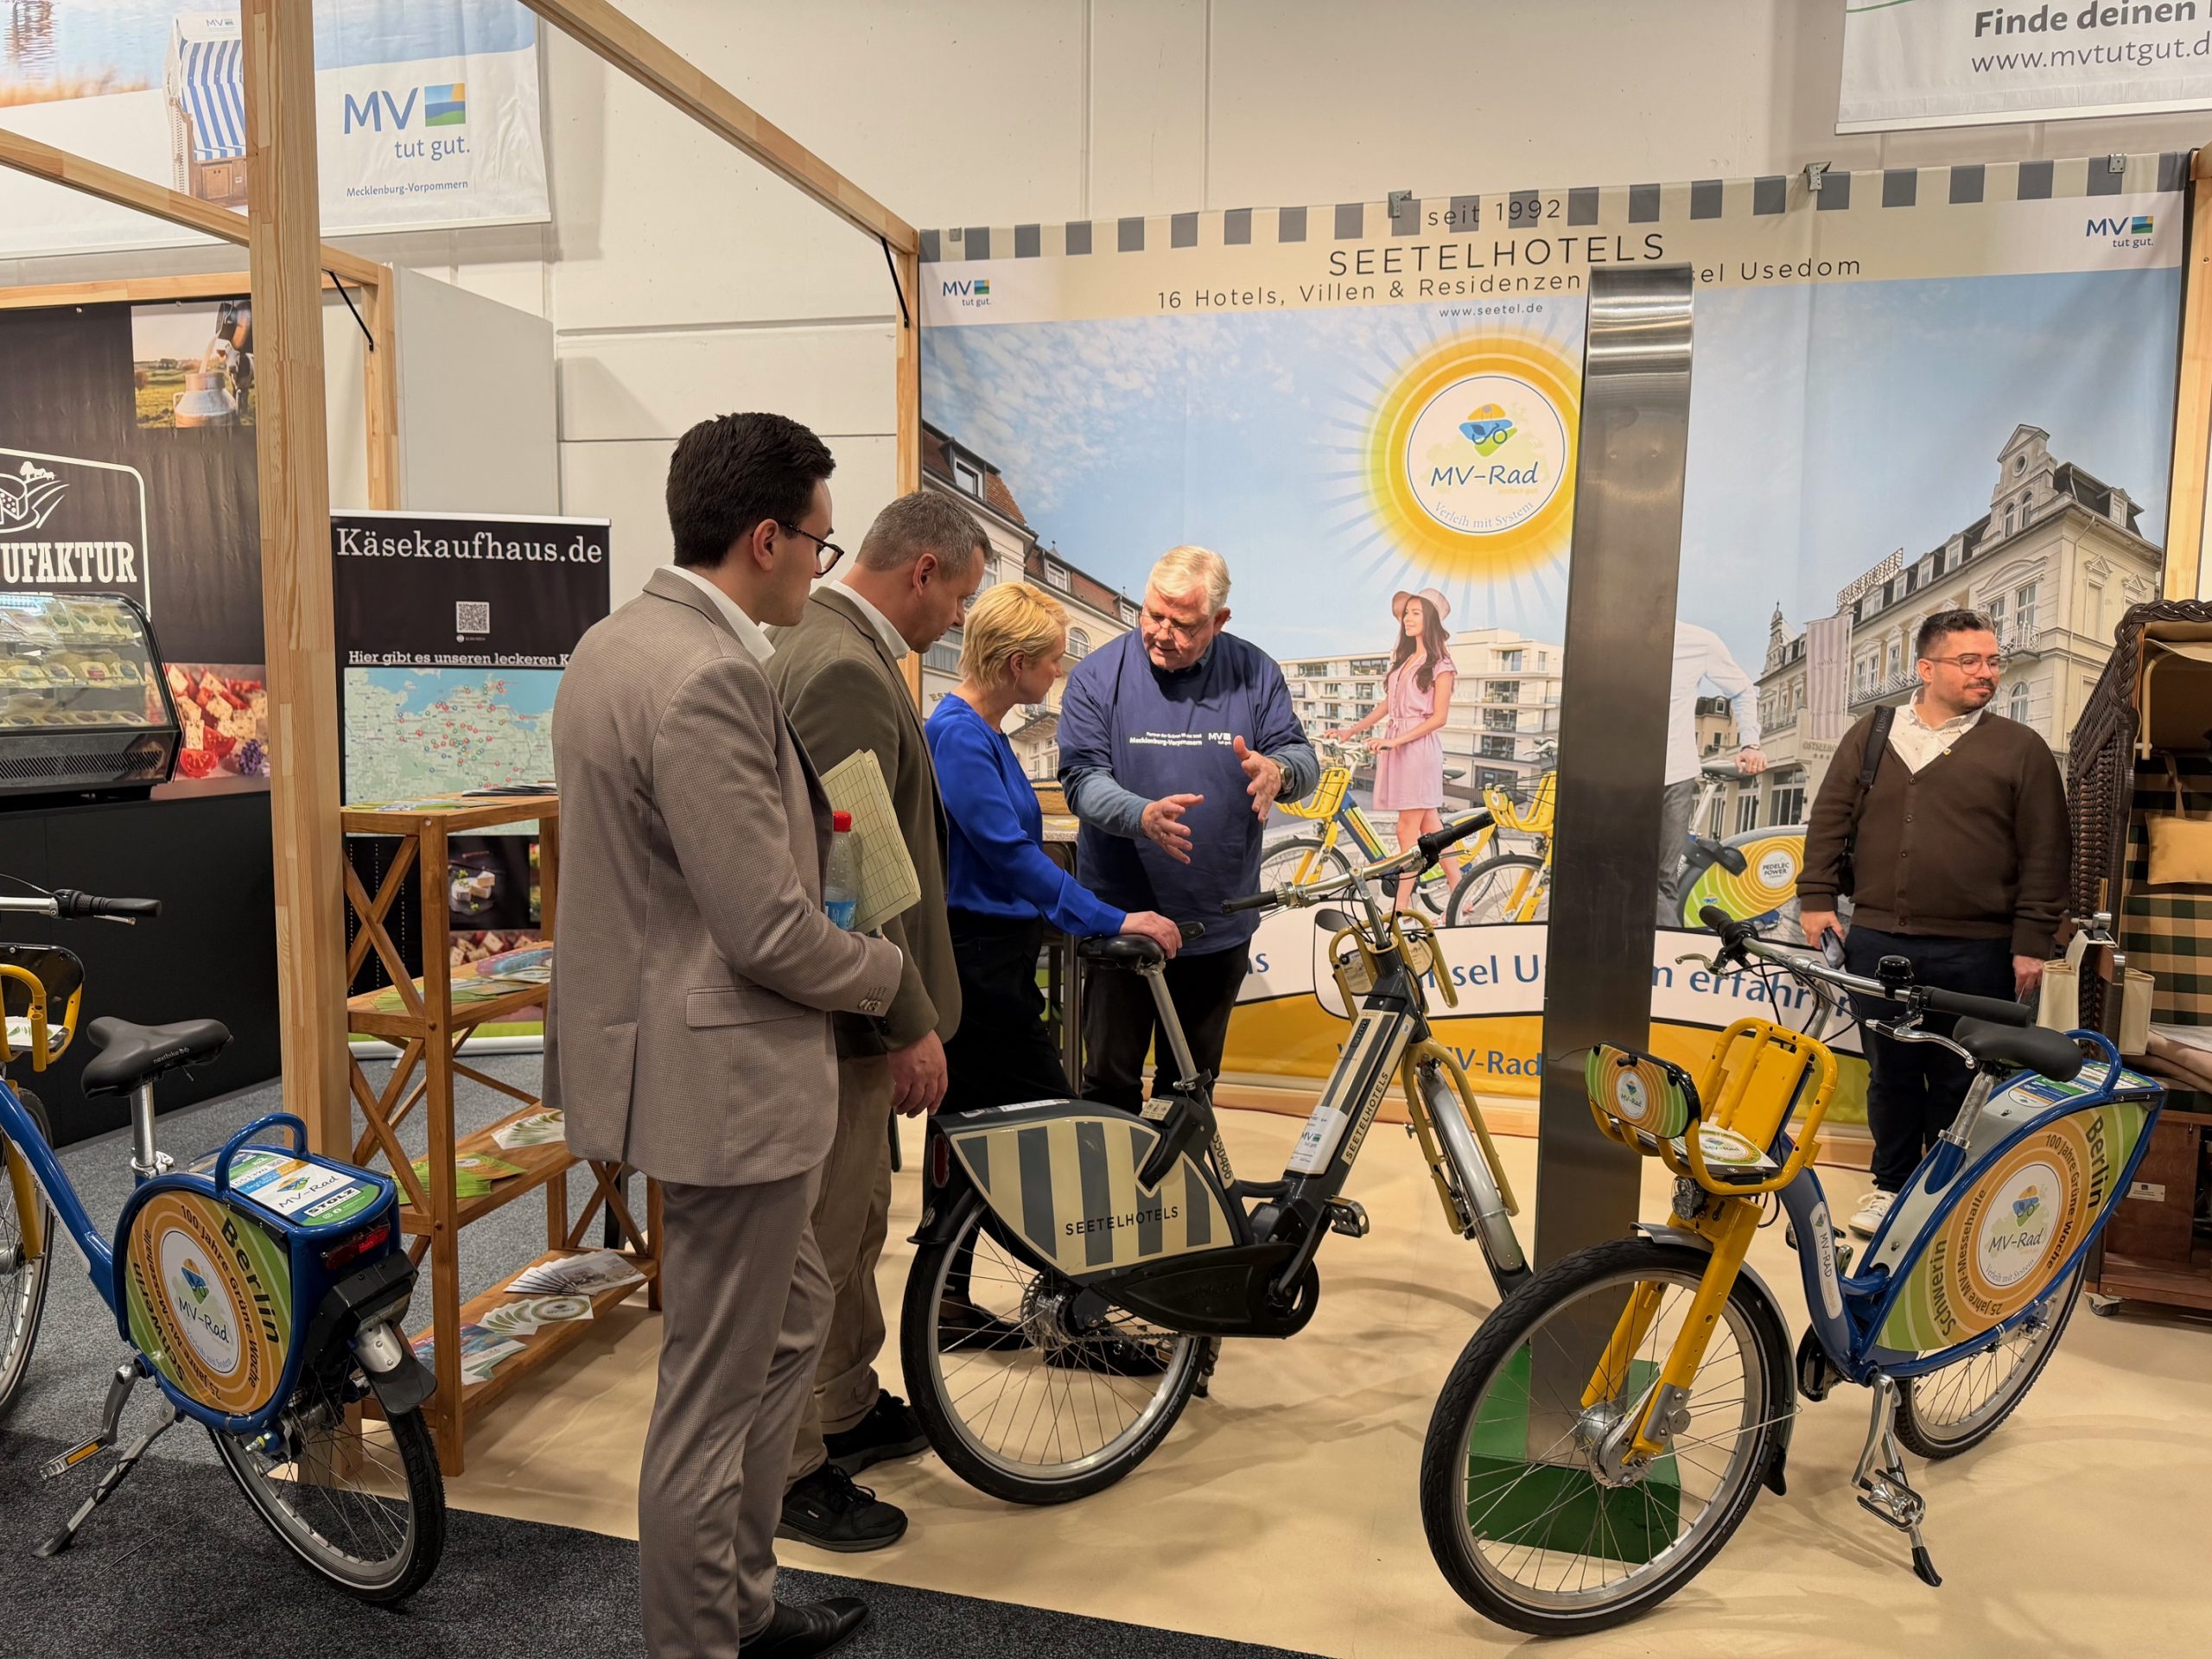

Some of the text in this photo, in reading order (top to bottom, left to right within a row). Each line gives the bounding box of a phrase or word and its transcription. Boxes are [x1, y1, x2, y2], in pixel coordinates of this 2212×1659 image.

[1975, 4, 2068, 37] Finde
[2076, 0, 2196, 29] deinen
[344, 87, 419, 135] MV
[394, 136, 470, 161] tut gut.
[346, 181, 468, 197] Mecklenburg-Vorpommern
[1427, 199, 1561, 226] seit 1992
[2086, 217, 2129, 237] MV
[1329, 233, 1665, 276] SEETELHOTELS
[2113, 238, 2153, 249] tut gut.
[943, 280, 972, 296] MV
[1158, 290, 1181, 308] 16
[1196, 287, 1285, 307] Hotels,
[1300, 283, 1376, 302] Villen
[1389, 280, 1405, 297] &
[1420, 272, 1580, 296] Residenzen
[1741, 257, 1859, 281] Usedom
[976, 297, 991, 308] gut.
[1439, 302, 1543, 318] www.seetel.de
[1431, 461, 1539, 487] MV-Rad
[1435, 501, 1534, 529] Verleih mit System
[0, 542, 137, 584] UFAKTUR
[336, 528, 602, 563] Käsekaufhaus.de
[349, 651, 380, 663] Hier
[383, 652, 411, 665] gibt
[415, 654, 431, 664] es
[434, 653, 492, 664] unseren
[494, 653, 557, 664] leckeren
[1208, 732, 1223, 741] MV
[1446, 1046, 1541, 1076] V-Rad
[1345, 1071, 1389, 1160] SEETELHOTELS
[1212, 1134, 1232, 1179] 550466
[2086, 1116, 2110, 1208] Berlin
[279, 1176, 340, 1209] MV-Rad
[308, 1188, 356, 1215] STOLZ
[2045, 1134, 2081, 1269] 100 Jahre Grüne Woche
[1065, 1205, 1179, 1236] SEETELHOTELS
[1820, 1232, 1833, 1278] MV-RAD
[1956, 1190, 2003, 1316] 25 Jahre MV-Messehalle
[1988, 1227, 2044, 1254] MV-Rad
[181, 1205, 260, 1389] 100 Jahre Grüne Woche
[220, 1217, 280, 1344] Berlin
[1929, 1240, 1957, 1338] Schwerin
[133, 1262, 185, 1382] Schwerin
[143, 1229, 222, 1400] 25 Jahre MV-Messehalle
[178, 1296, 229, 1344] MV-Rad
